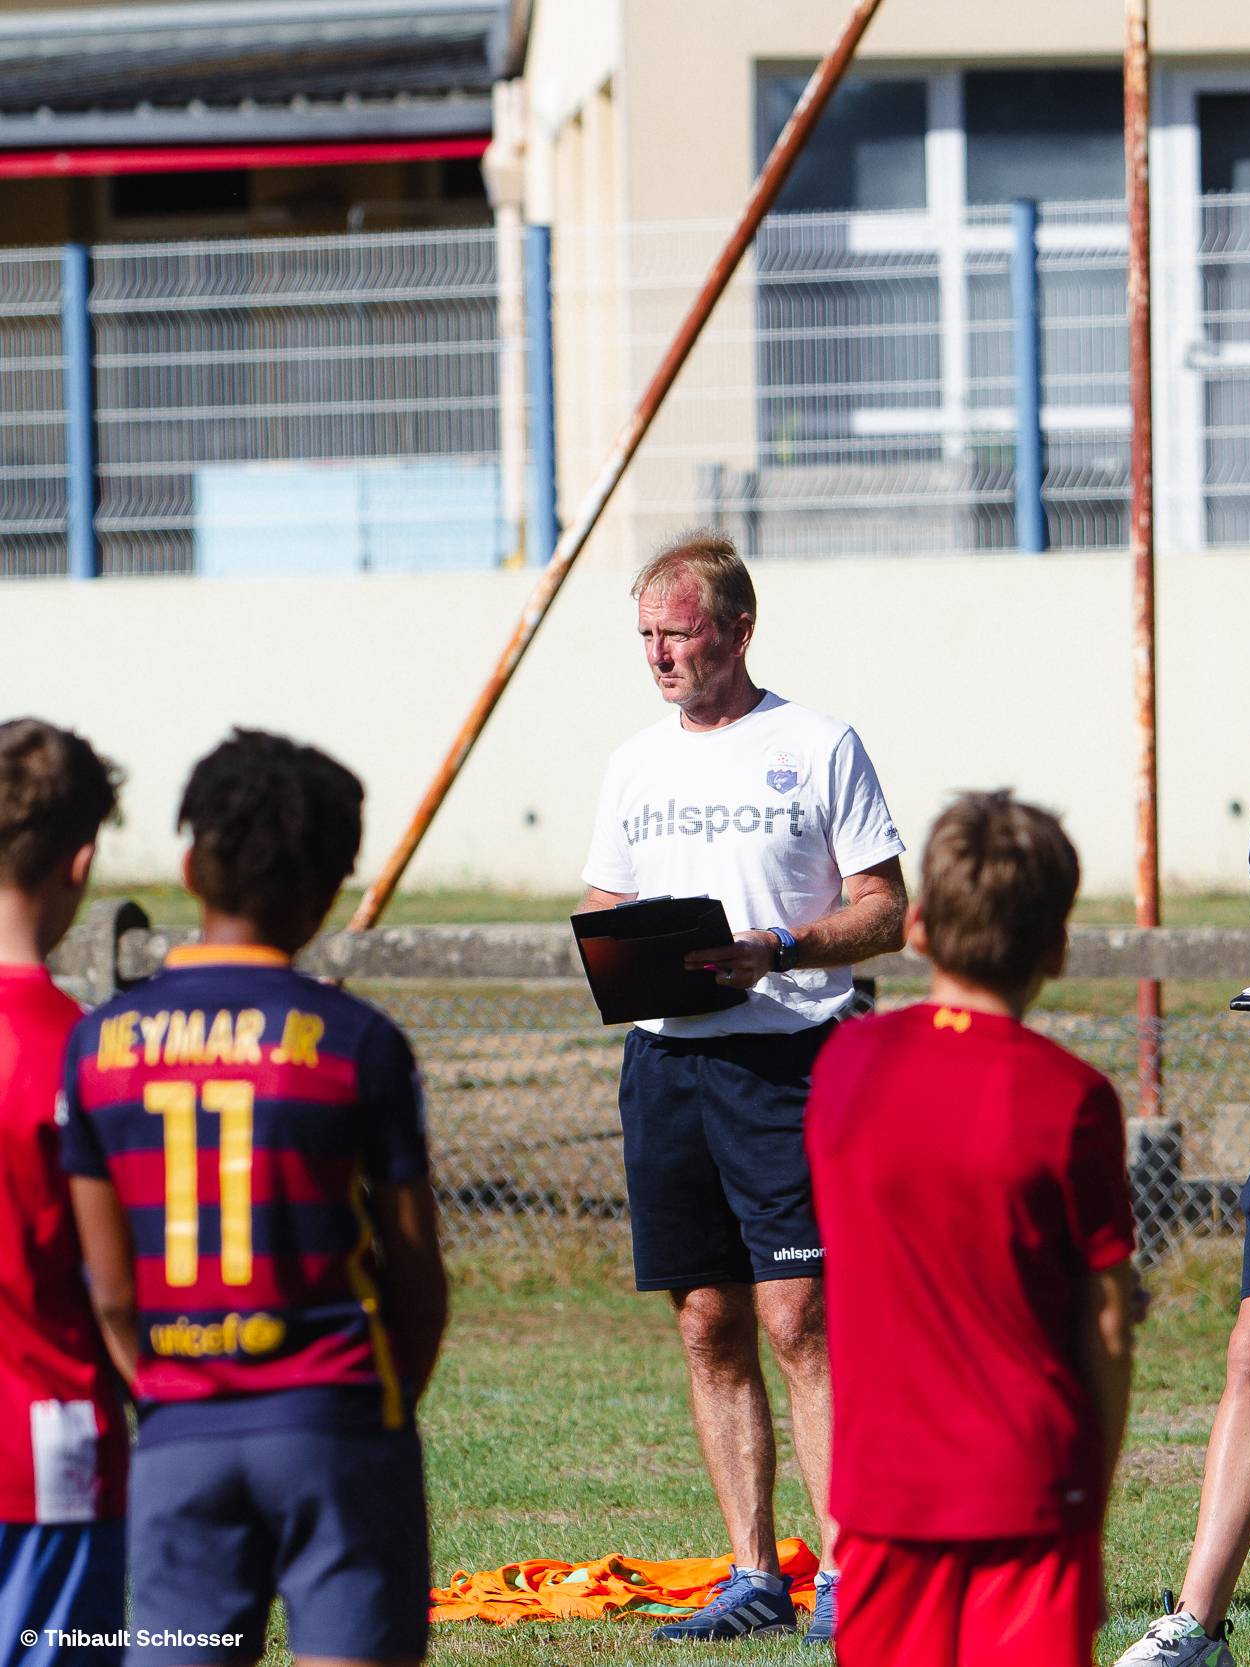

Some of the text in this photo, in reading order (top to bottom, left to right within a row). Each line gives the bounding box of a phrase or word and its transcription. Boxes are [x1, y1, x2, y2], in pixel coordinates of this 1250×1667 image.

[622, 799, 805, 846] uhlsport
[97, 1008, 326, 1072] NEYMAR JR
[143, 1080, 255, 1287] 11
